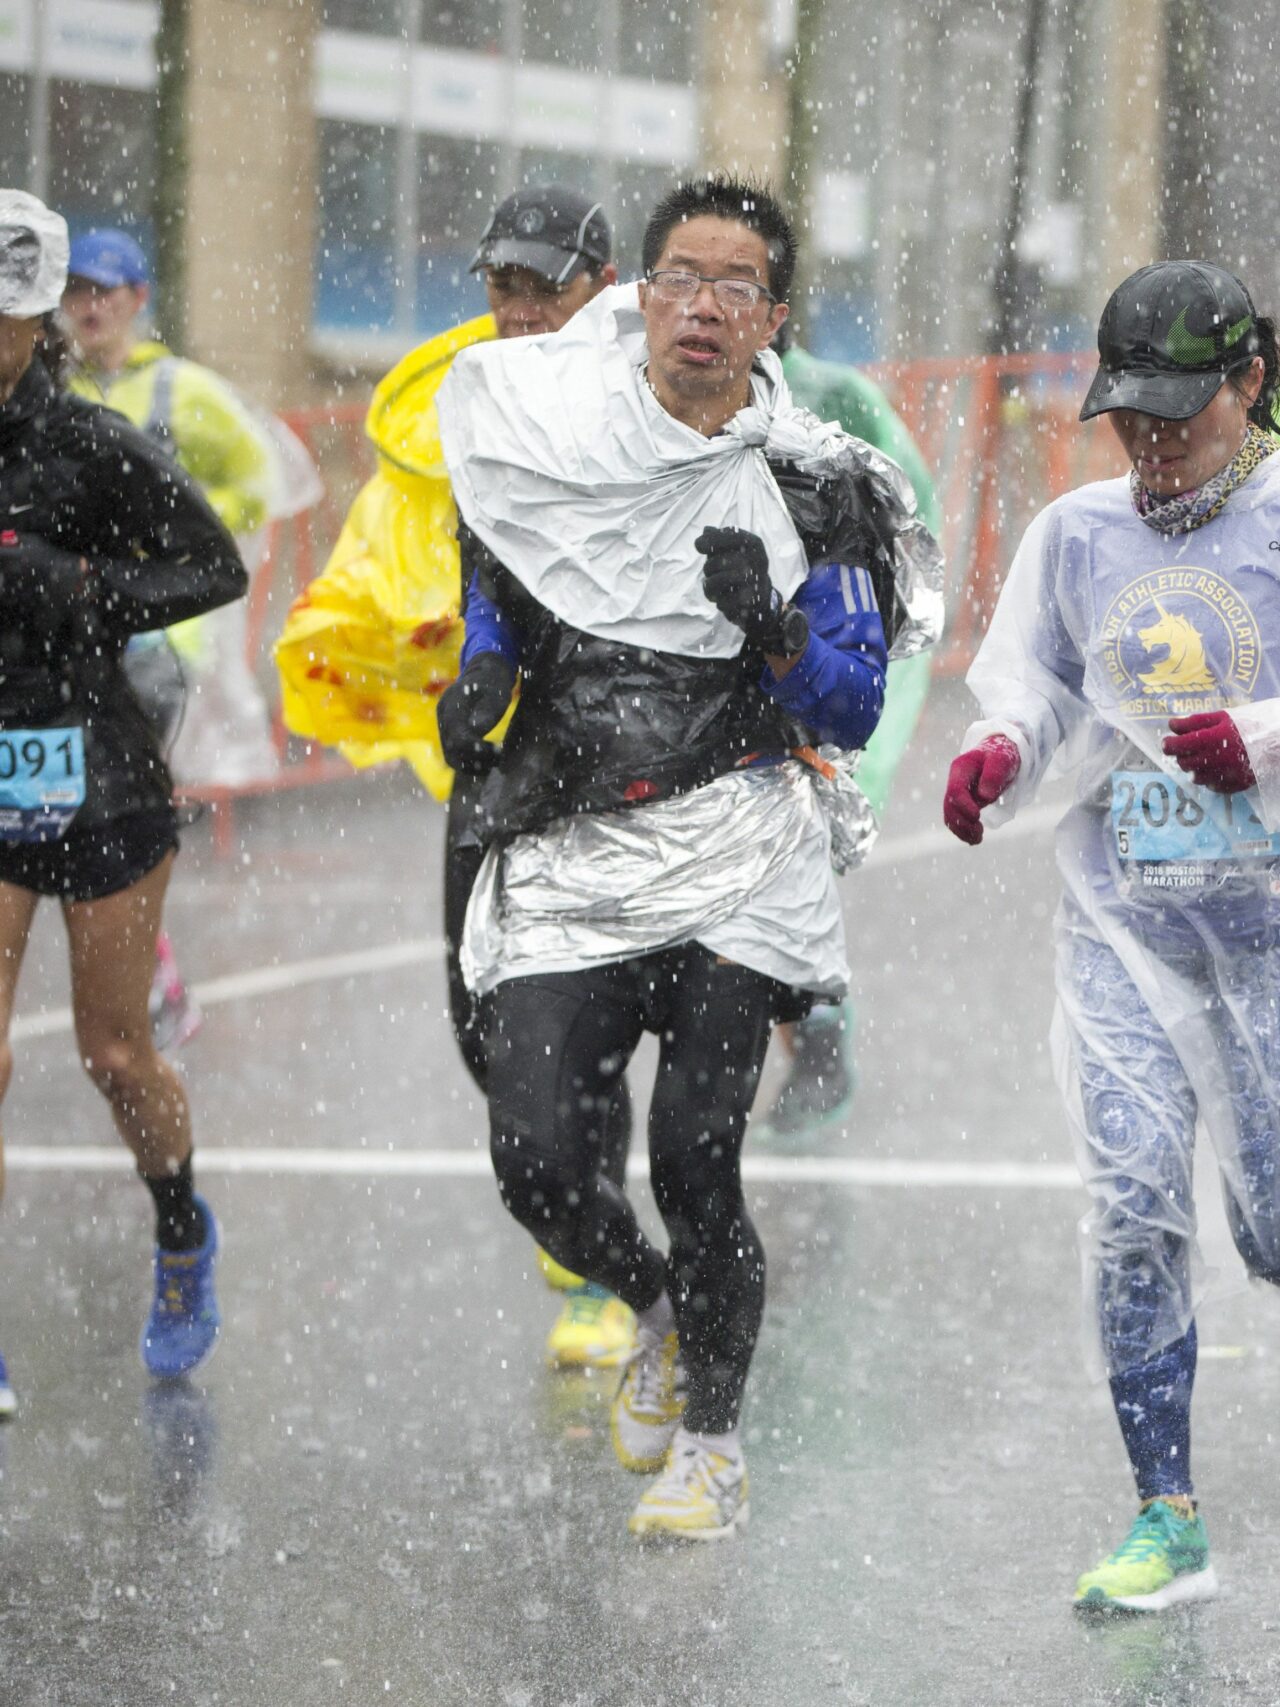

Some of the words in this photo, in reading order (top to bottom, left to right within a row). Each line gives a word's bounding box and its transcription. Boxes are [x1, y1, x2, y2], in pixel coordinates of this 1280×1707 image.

[1118, 572, 1193, 616] ATHLETIC
[1195, 575, 1255, 682] ASSOCIATION
[1118, 780, 1262, 828] 2081
[1118, 831, 1129, 854] 5
[1143, 865, 1164, 876] 2018
[1165, 865, 1205, 876] BOSTON
[1143, 876, 1206, 888] MARATHON
